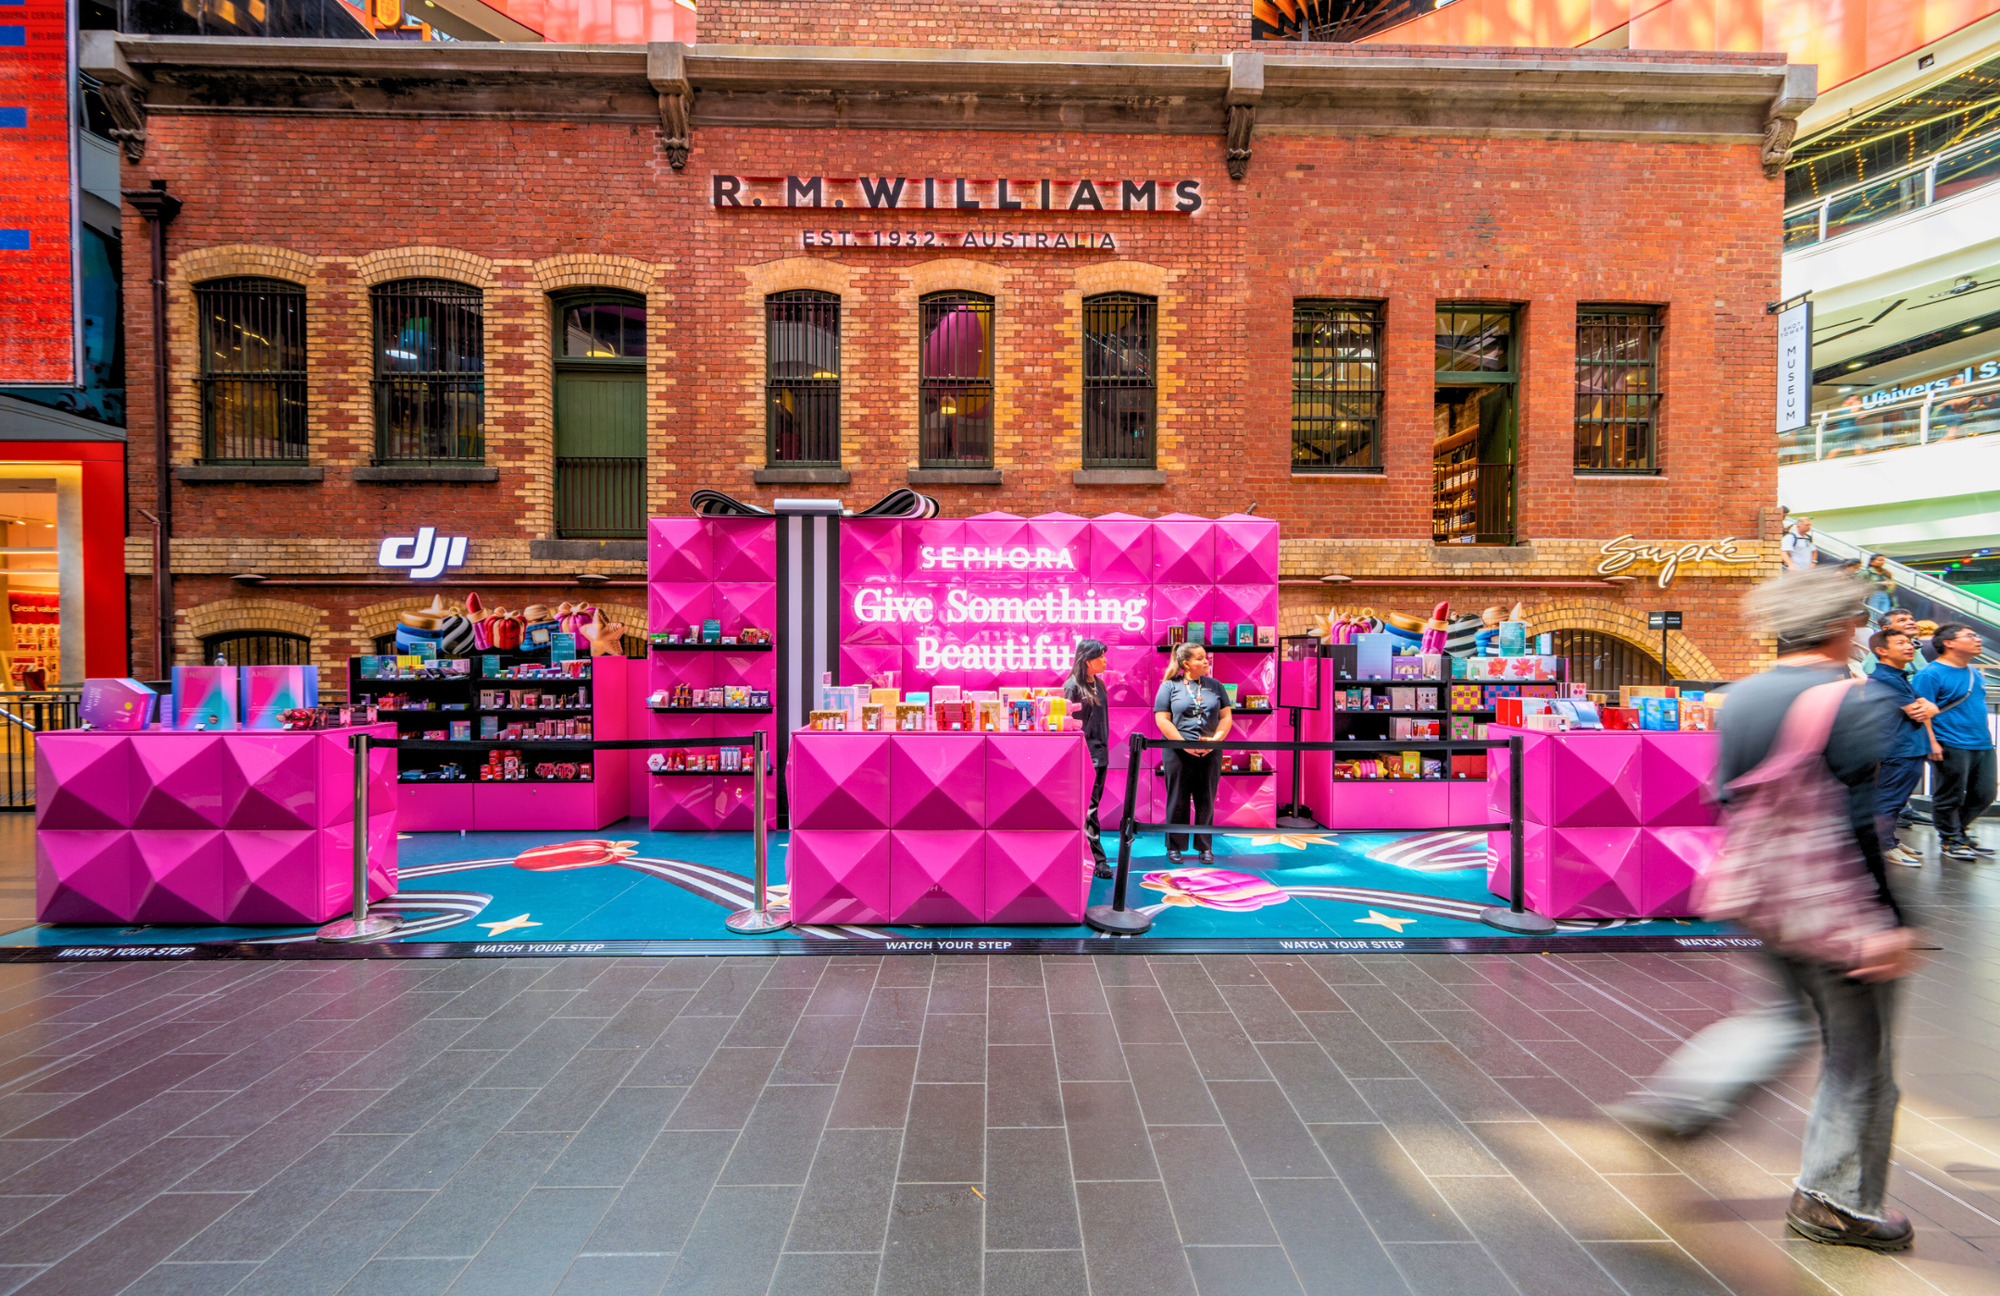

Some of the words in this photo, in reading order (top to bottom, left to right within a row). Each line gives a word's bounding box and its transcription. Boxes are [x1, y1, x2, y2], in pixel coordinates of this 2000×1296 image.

[803, 230, 858, 246] EST.
[962, 231, 1116, 249] AUSTRALIA
[1783, 321, 1802, 331] SHOT
[1780, 326, 1805, 338] TOWER
[1786, 346, 1797, 422] MUSEUM
[1861, 366, 1974, 410] Universl
[921, 546, 1075, 569] SEPHORA
[12, 604, 36, 612] Great
[854, 586, 934, 624] Give
[946, 588, 1148, 632] Something
[915, 634, 1083, 670] Beautifu
[473, 944, 525, 953] WATCH
[527, 944, 566, 953] YOUR
[567, 943, 605, 952] STEP
[885, 941, 933, 950] WATCH
[937, 941, 974, 950] YOUR
[978, 941, 1012, 950] STEP
[1279, 940, 1329, 949] WATCH
[1329, 940, 1370, 949] YOUR
[1370, 940, 1405, 949] STEP
[1674, 938, 1728, 947] WATCH
[57, 948, 115, 957] WATCH
[112, 947, 156, 956] YOUR
[153, 947, 196, 956] STEP
